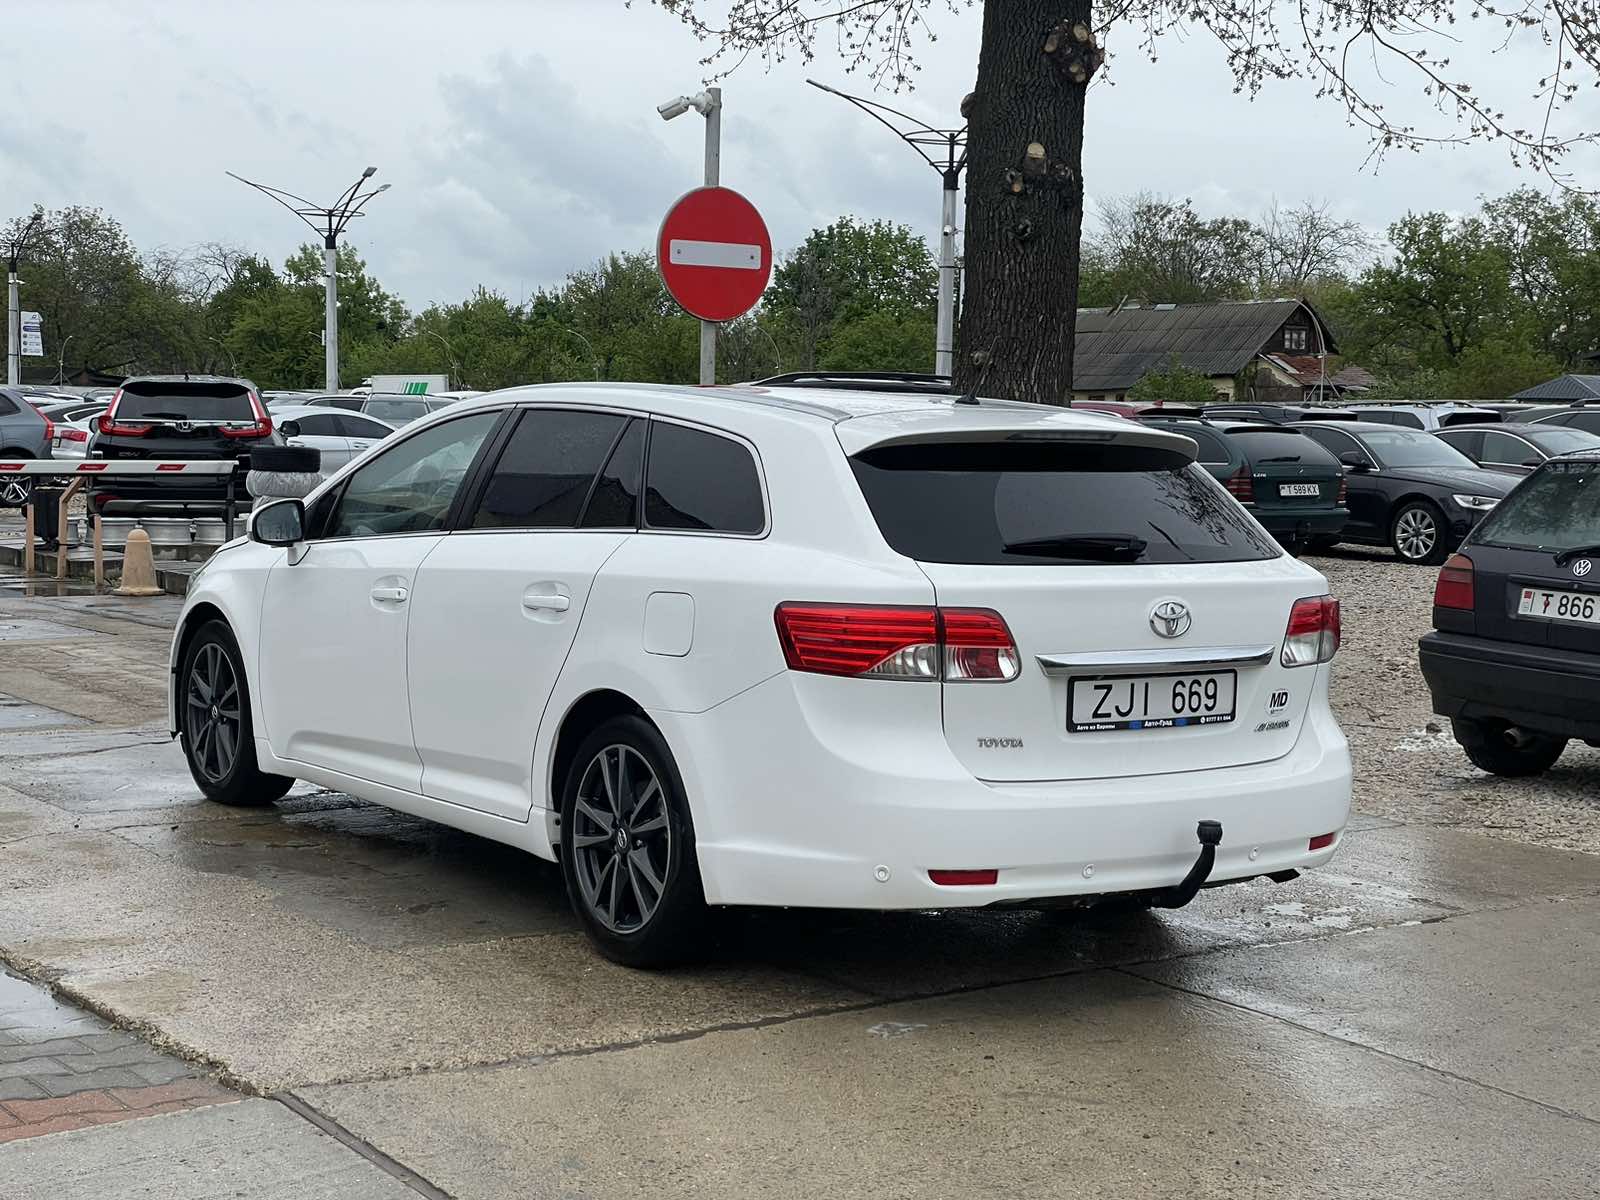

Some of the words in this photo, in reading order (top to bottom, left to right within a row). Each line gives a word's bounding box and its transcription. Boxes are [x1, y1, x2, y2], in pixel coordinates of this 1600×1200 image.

[1286, 486, 1293, 494] T
[1307, 484, 1318, 494] KX
[1541, 593, 1554, 614] T
[1557, 594, 1595, 619] 866
[1092, 682, 1149, 719] ZJI
[1171, 678, 1218, 714] 669
[1269, 691, 1289, 708] MD
[976, 737, 1024, 749] TOYOTA
